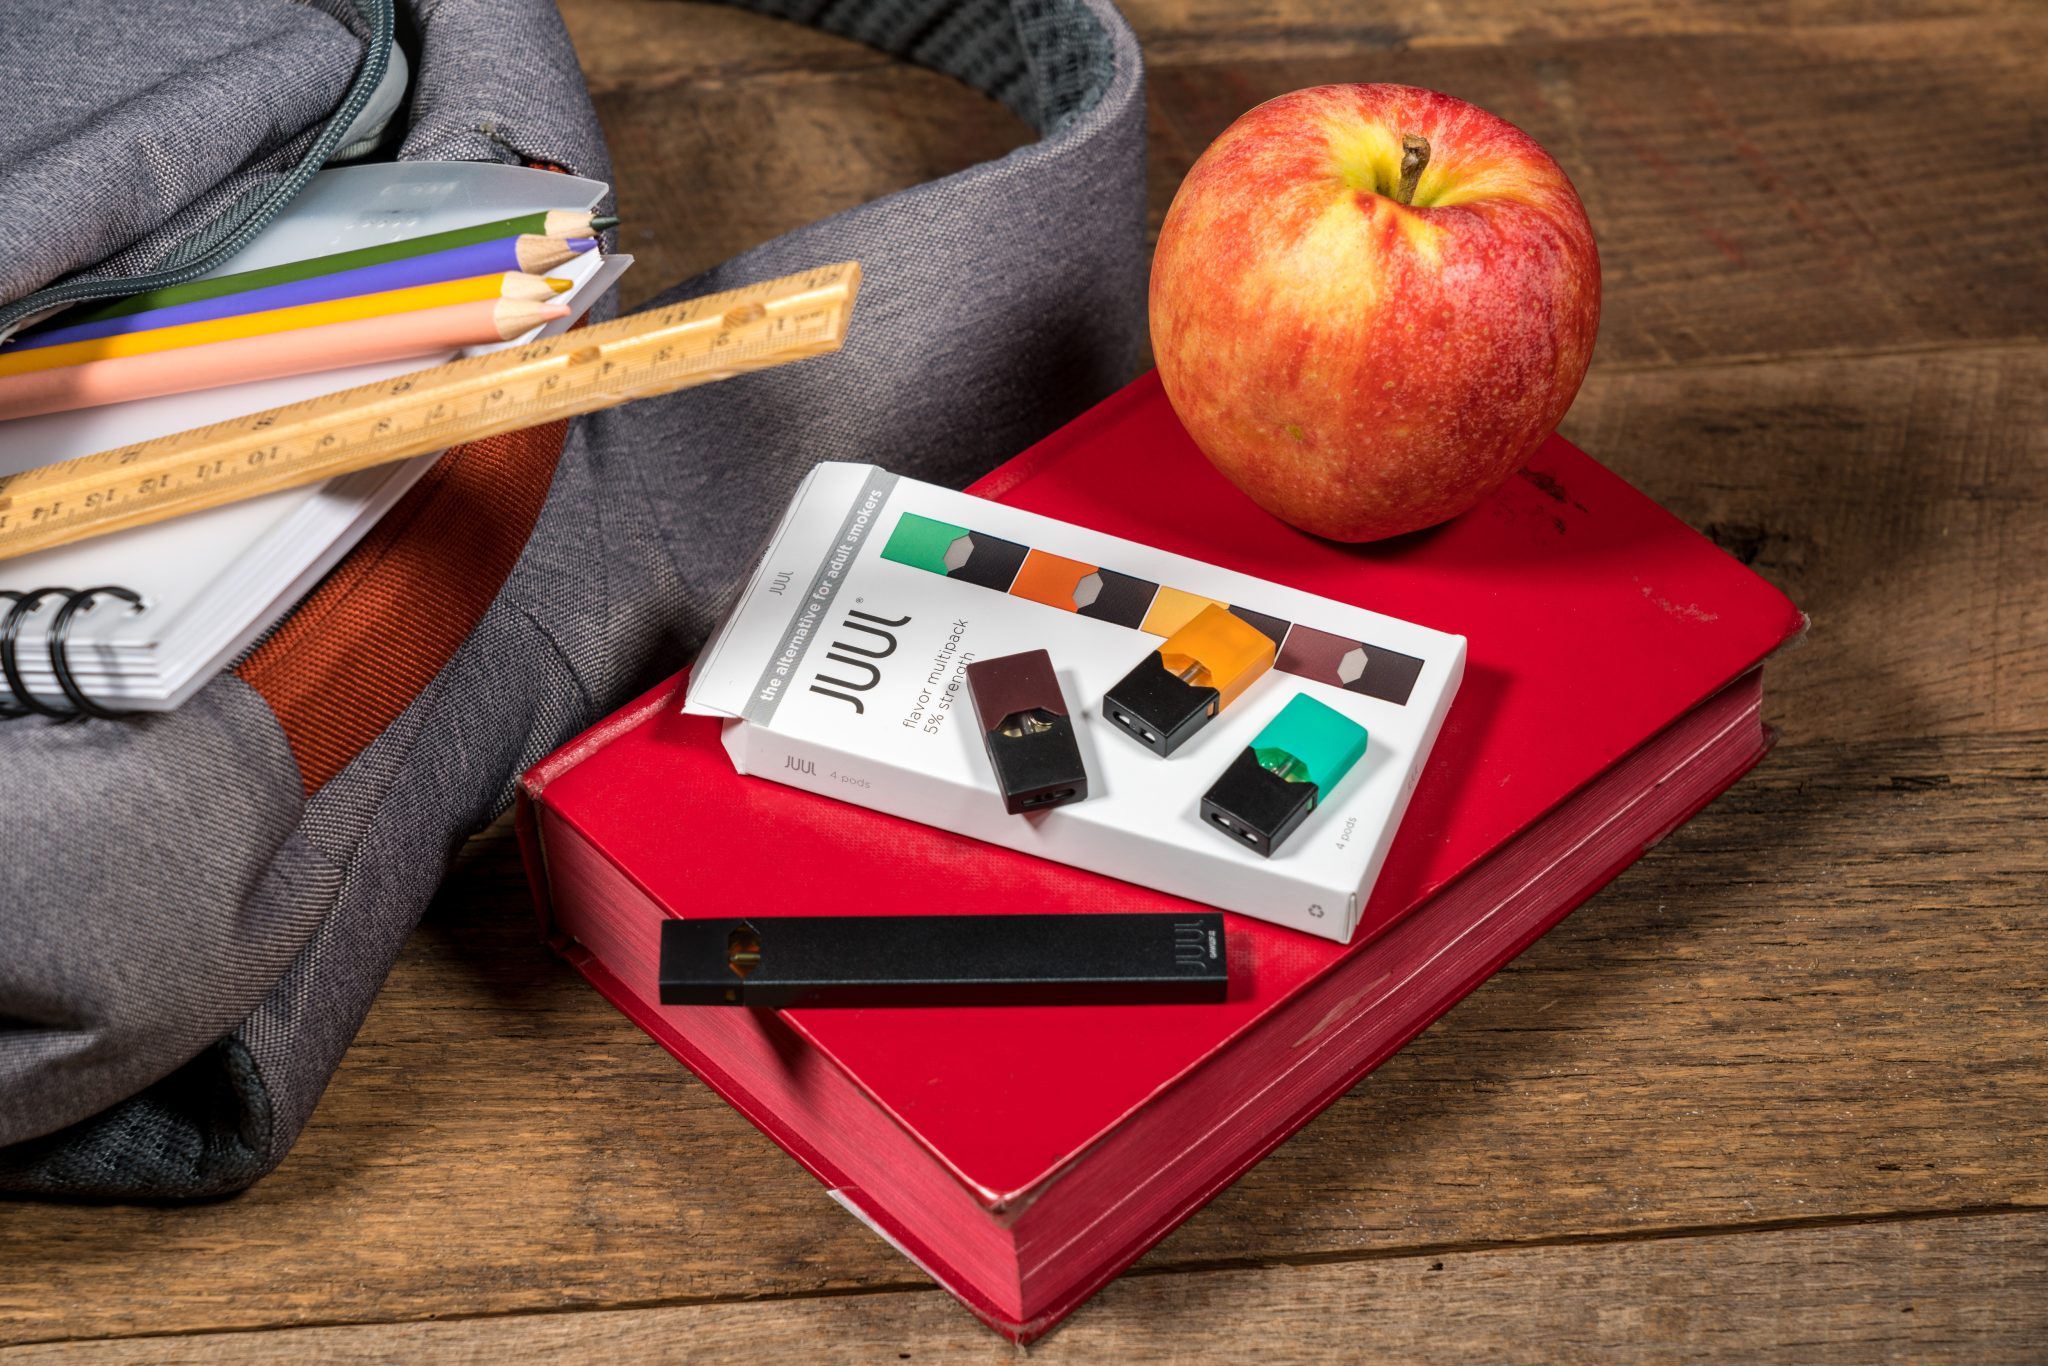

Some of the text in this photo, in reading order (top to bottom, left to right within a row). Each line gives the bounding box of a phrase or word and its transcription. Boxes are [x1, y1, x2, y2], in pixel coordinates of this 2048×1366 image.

[521, 346, 551, 362] 10
[248, 446, 278, 465] 10
[197, 460, 223, 478] 11
[138, 474, 169, 493] 12
[85, 488, 115, 507] 13
[32, 501, 62, 520] 14
[760, 489, 882, 701] the alternative for adult smokers
[768, 571, 794, 596] JUUL
[809, 609, 912, 715] JUUL
[902, 618, 969, 729] flavor multipack
[923, 712, 944, 735] 5%
[784, 755, 871, 789] JUUL 4 pods
[1336, 817, 1357, 850] 4 pods
[1174, 919, 1207, 969] JUUL
